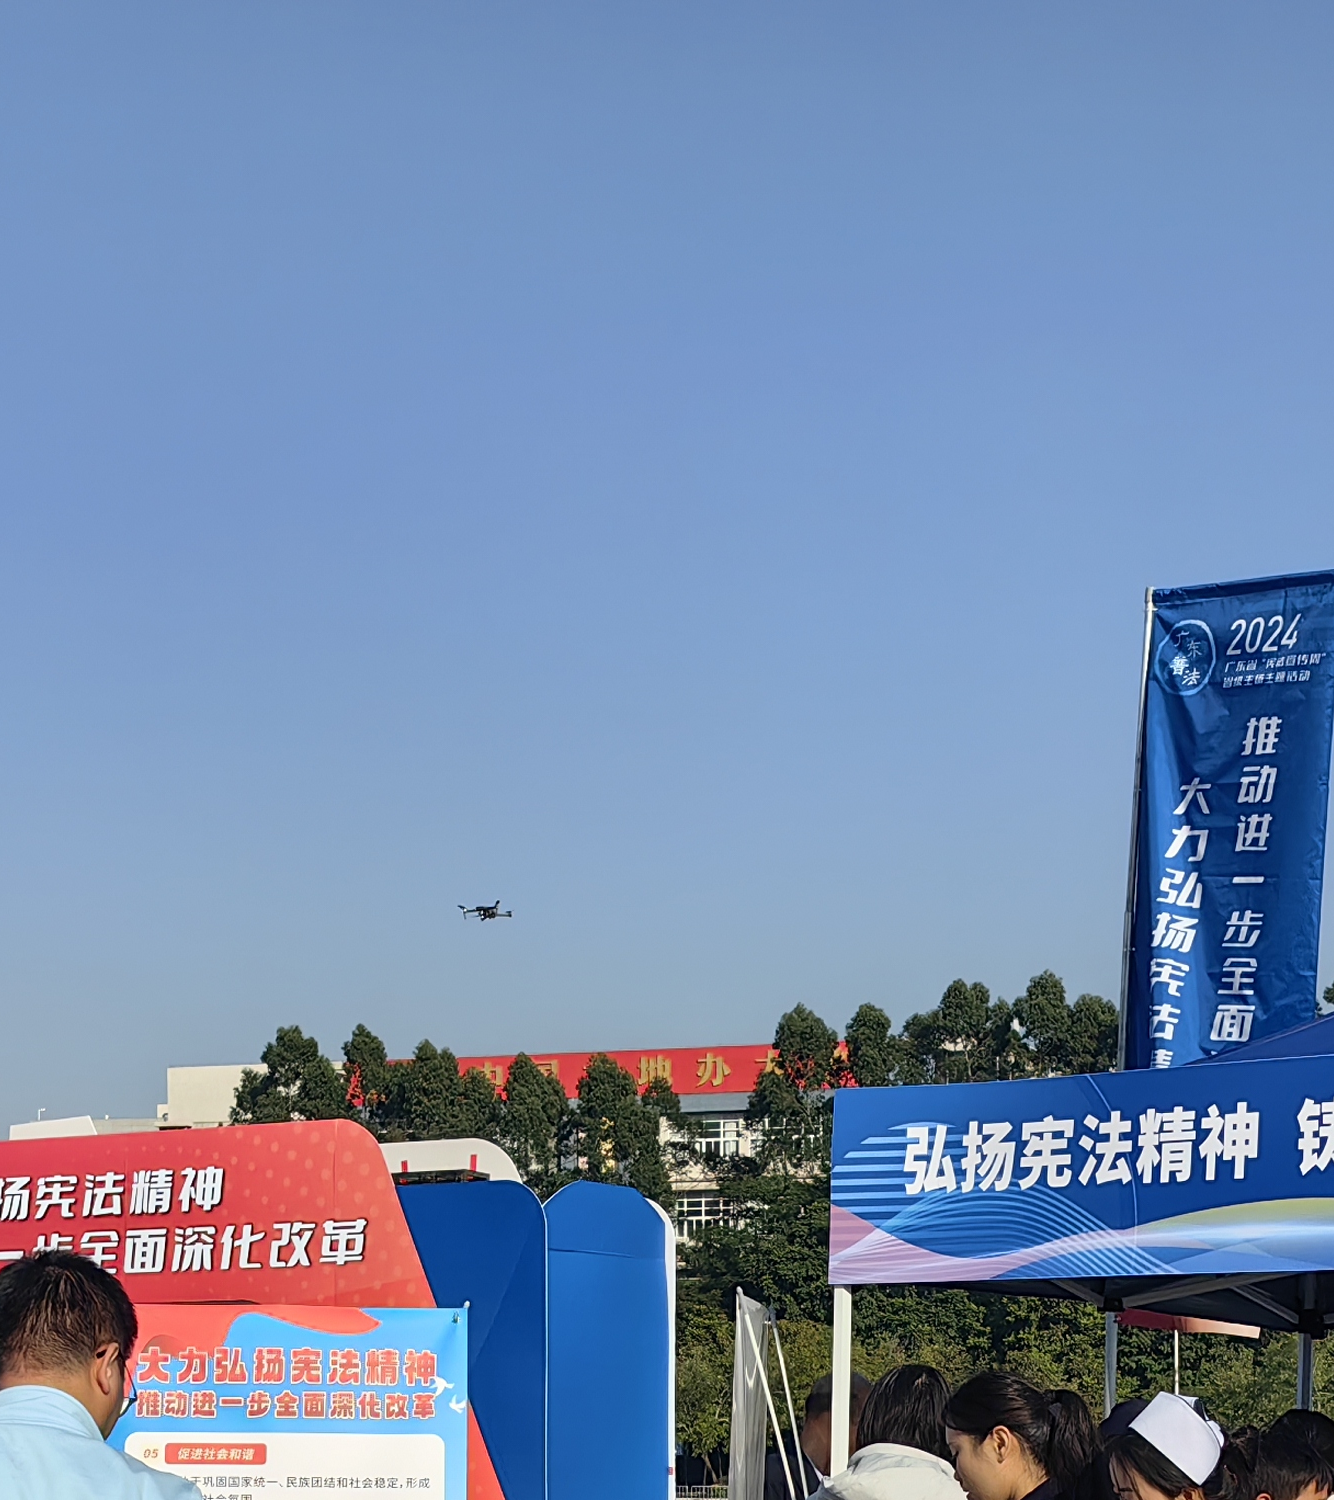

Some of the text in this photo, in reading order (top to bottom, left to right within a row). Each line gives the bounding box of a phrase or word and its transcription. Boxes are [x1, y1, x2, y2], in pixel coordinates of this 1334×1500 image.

[1226, 613, 1302, 656] 2024
[1210, 716, 1283, 1042] 推动进一步全面
[903, 1101, 1261, 1195] 弘扬宪法精神
[137, 1347, 437, 1386] 大力弘扬宪法精神
[135, 1391, 436, 1420] 推动进一步全面深化改革
[143, 1447, 255, 1461] 05 促进社会和谐
